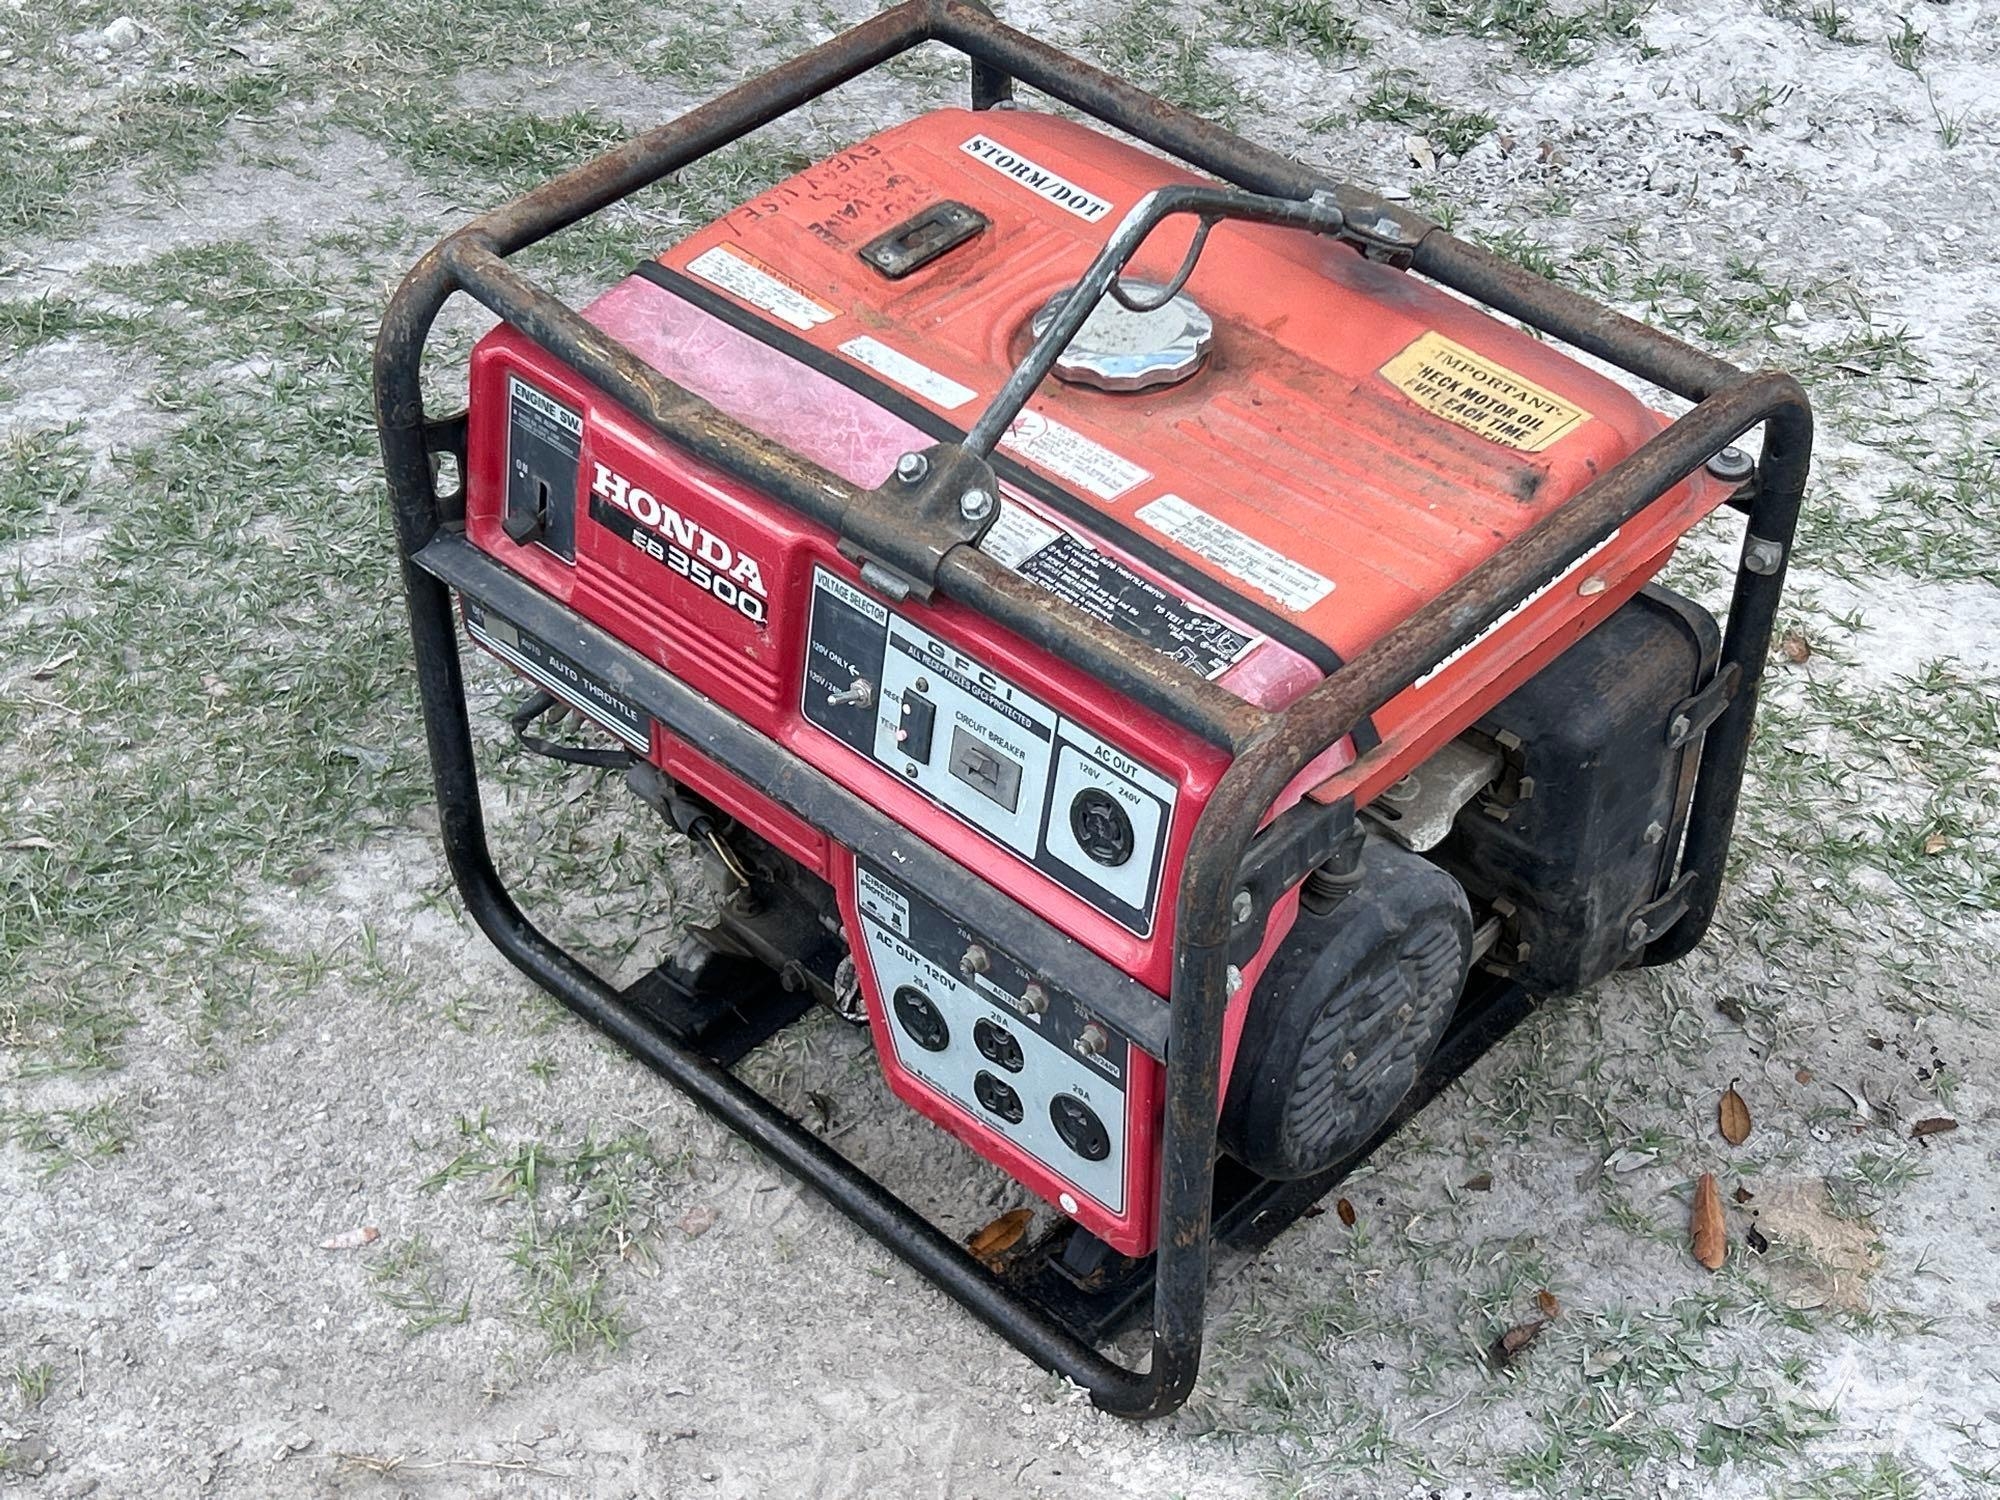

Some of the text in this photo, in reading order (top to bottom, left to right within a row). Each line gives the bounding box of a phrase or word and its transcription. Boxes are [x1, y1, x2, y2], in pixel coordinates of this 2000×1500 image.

[966, 139, 1105, 216] STORM/DOT
[515, 383, 556, 417] ENGINE
[1418, 362, 1462, 393] HECK
[1460, 384, 1519, 419] MOTOR
[1517, 413, 1545, 432] OIL
[1442, 397, 1488, 423] EACH
[1487, 417, 1531, 441] TIME
[516, 458, 528, 474] ON
[592, 461, 768, 598] HONDA
[817, 571, 886, 623] VOLTAGE SELECTOR
[1153, 604, 1185, 626] TO TEST
[811, 639, 850, 671] 120V ONLY
[907, 645, 921, 659] ALL
[921, 653, 972, 691] RECEPTACLES
[549, 655, 639, 723] AUTO THROTTLE
[880, 716, 898, 733] TEST
[955, 711, 1026, 760] CIRCUIT BREAKER
[1094, 745, 1139, 779] AC OUT
[1079, 761, 1101, 780] 120V
[1118, 787, 1142, 806] 240V
[860, 879, 907, 916] PROTECTOR
[865, 874, 900, 901] CIRCUIT
[957, 927, 973, 942] 20A
[876, 930, 957, 993] AC OUT 120V
[990, 1010, 1010, 1028] 20A
